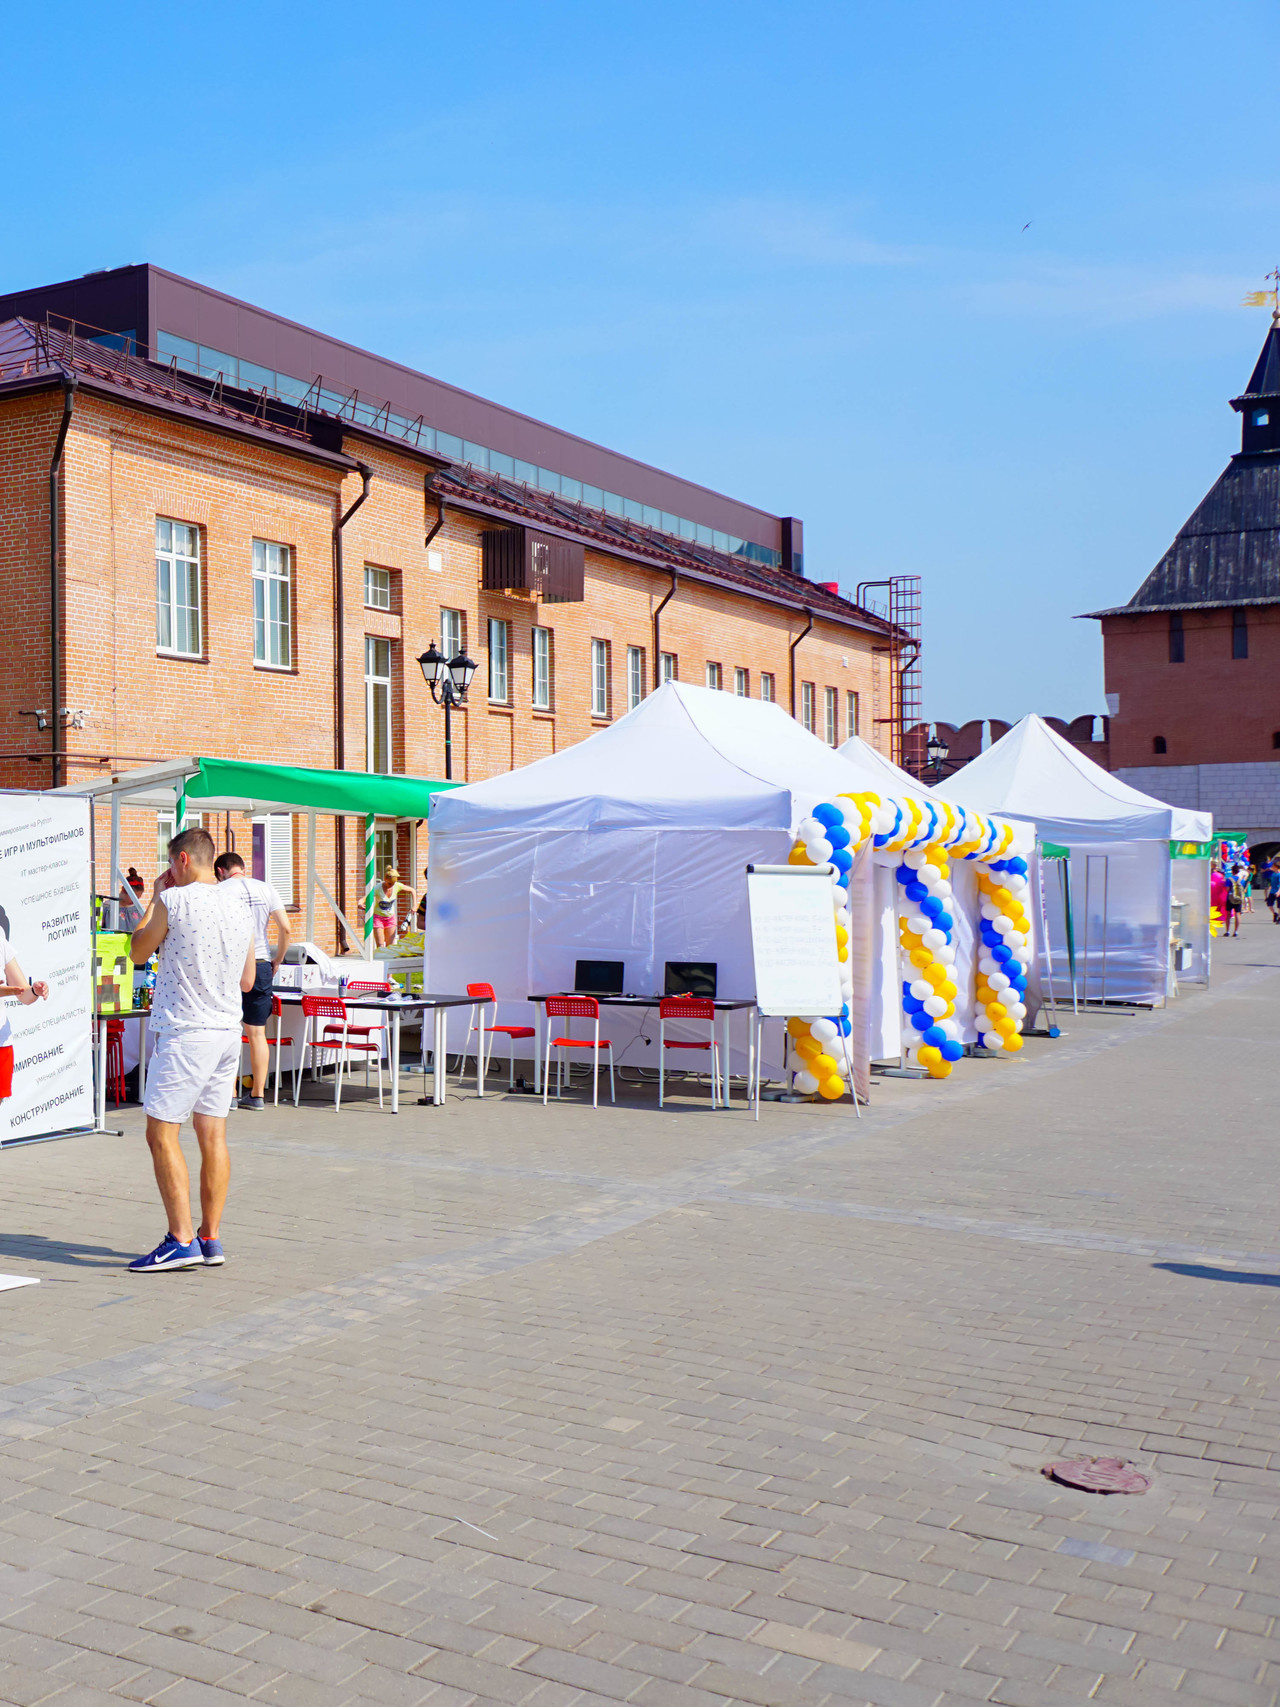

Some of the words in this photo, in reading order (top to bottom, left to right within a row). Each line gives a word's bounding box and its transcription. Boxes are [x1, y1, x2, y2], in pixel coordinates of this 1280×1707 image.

[4, 845, 19, 858] ИГР
[19, 844, 26, 853] И
[26, 827, 85, 851] МУЛЬТФИЛЬМОВ
[27, 859, 68, 876] мастер-классы
[20, 889, 52, 907] УСПЕШНОЕ
[53, 881, 80, 897] БУДУЩЕЕ
[41, 910, 80, 931] РАЗВИТИЕ
[47, 925, 78, 943] ЛОГИКИ
[49, 964, 75, 979] создание
[57, 979, 65, 987] на
[42, 1006, 86, 1029] СПЕЦИАЛИСТЫ
[14, 1044, 65, 1073] МИРОВАНИЕ
[9, 1084, 85, 1129] КОНСТРУИРОВАНИЕ
